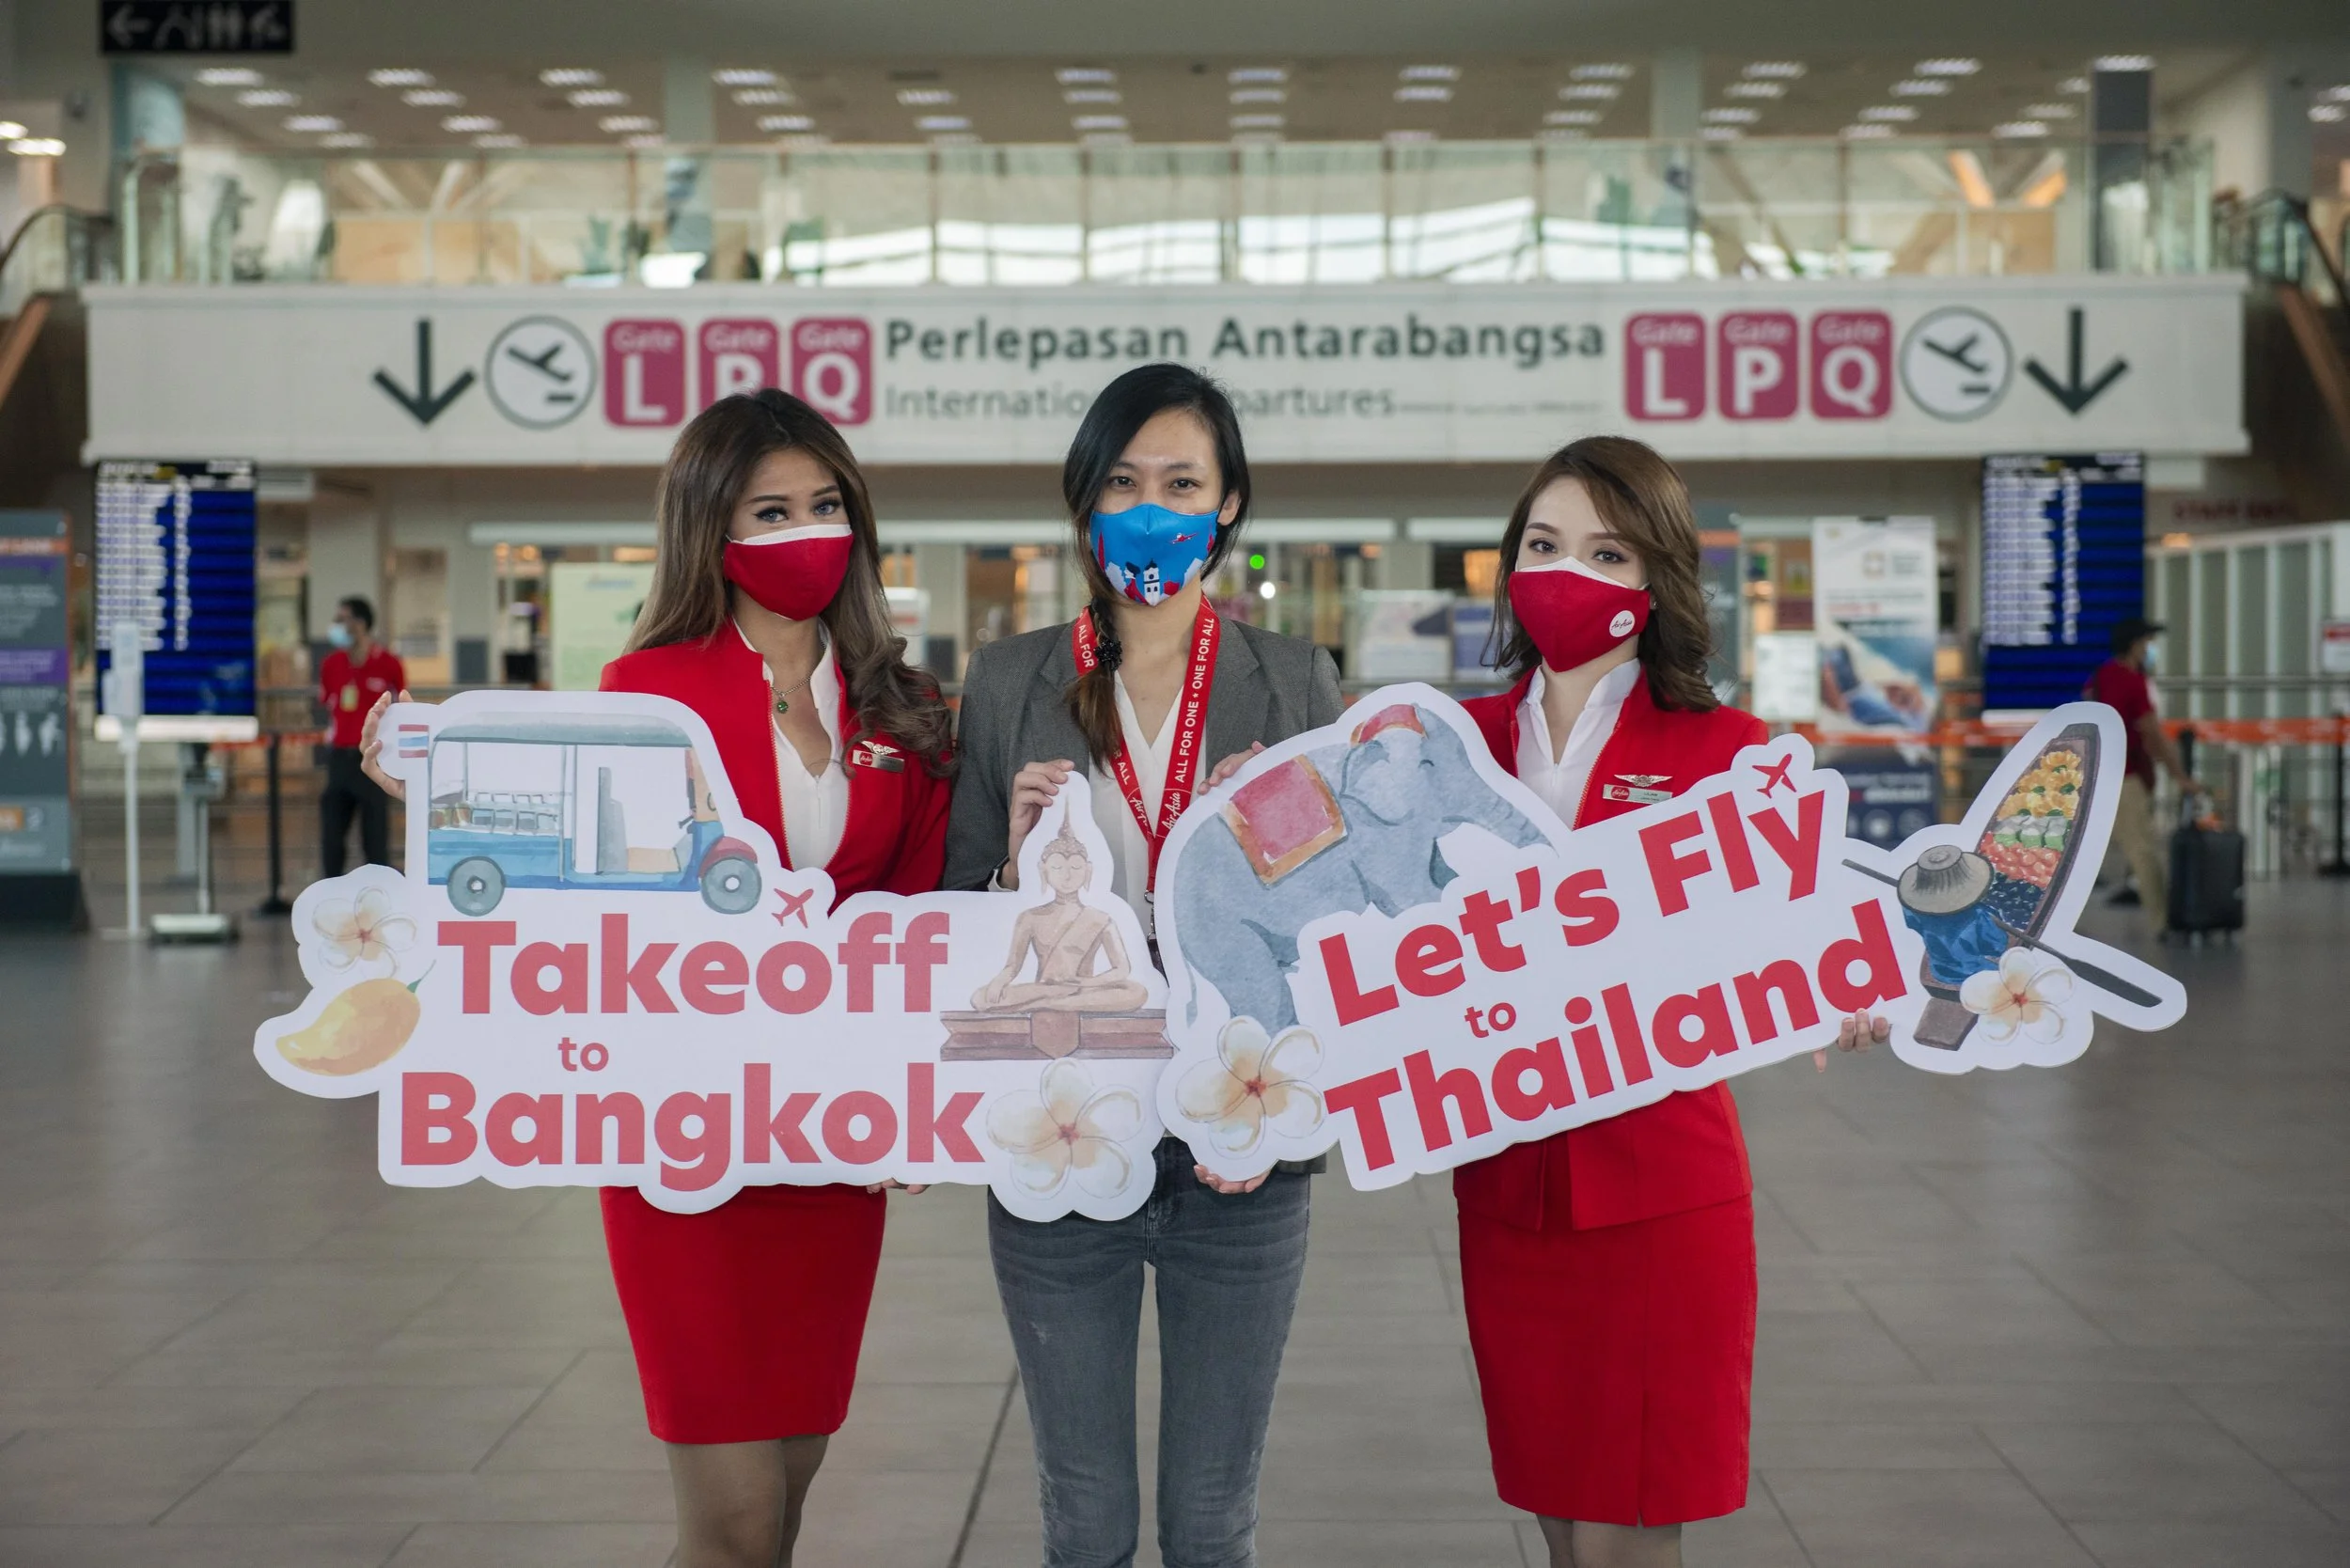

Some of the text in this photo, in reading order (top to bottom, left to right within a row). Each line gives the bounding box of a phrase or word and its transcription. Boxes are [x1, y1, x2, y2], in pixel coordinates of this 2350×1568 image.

[612, 325, 678, 352] Gate
[704, 325, 773, 352] Gate
[799, 324, 865, 351] Gate
[885, 314, 1606, 370] Perlepasan Antarabangsa
[1632, 319, 1697, 346] Gate
[1724, 318, 1791, 345] Gate
[1816, 317, 1883, 345] Gate
[623, 353, 667, 420] L
[803, 351, 863, 420] Q
[885, 380, 1090, 419] Internatio
[1644, 349, 1688, 416] L
[1734, 347, 1782, 415] P
[1822, 347, 1879, 415] Q
[1078, 624, 1095, 668] ALL FOR
[1174, 618, 1214, 783] ALL FOR ONE ONE FOR ALL
[1117, 761, 1131, 786] ALL
[1161, 792, 1181, 830] AirAsia
[1319, 791, 1825, 1026] Let's Fly
[437, 913, 949, 1015] Takeoff
[1324, 898, 1907, 1171] Thailand
[1465, 1002, 1516, 1039] to
[557, 1037, 609, 1073] to
[401, 1063, 985, 1192] Bangkok
